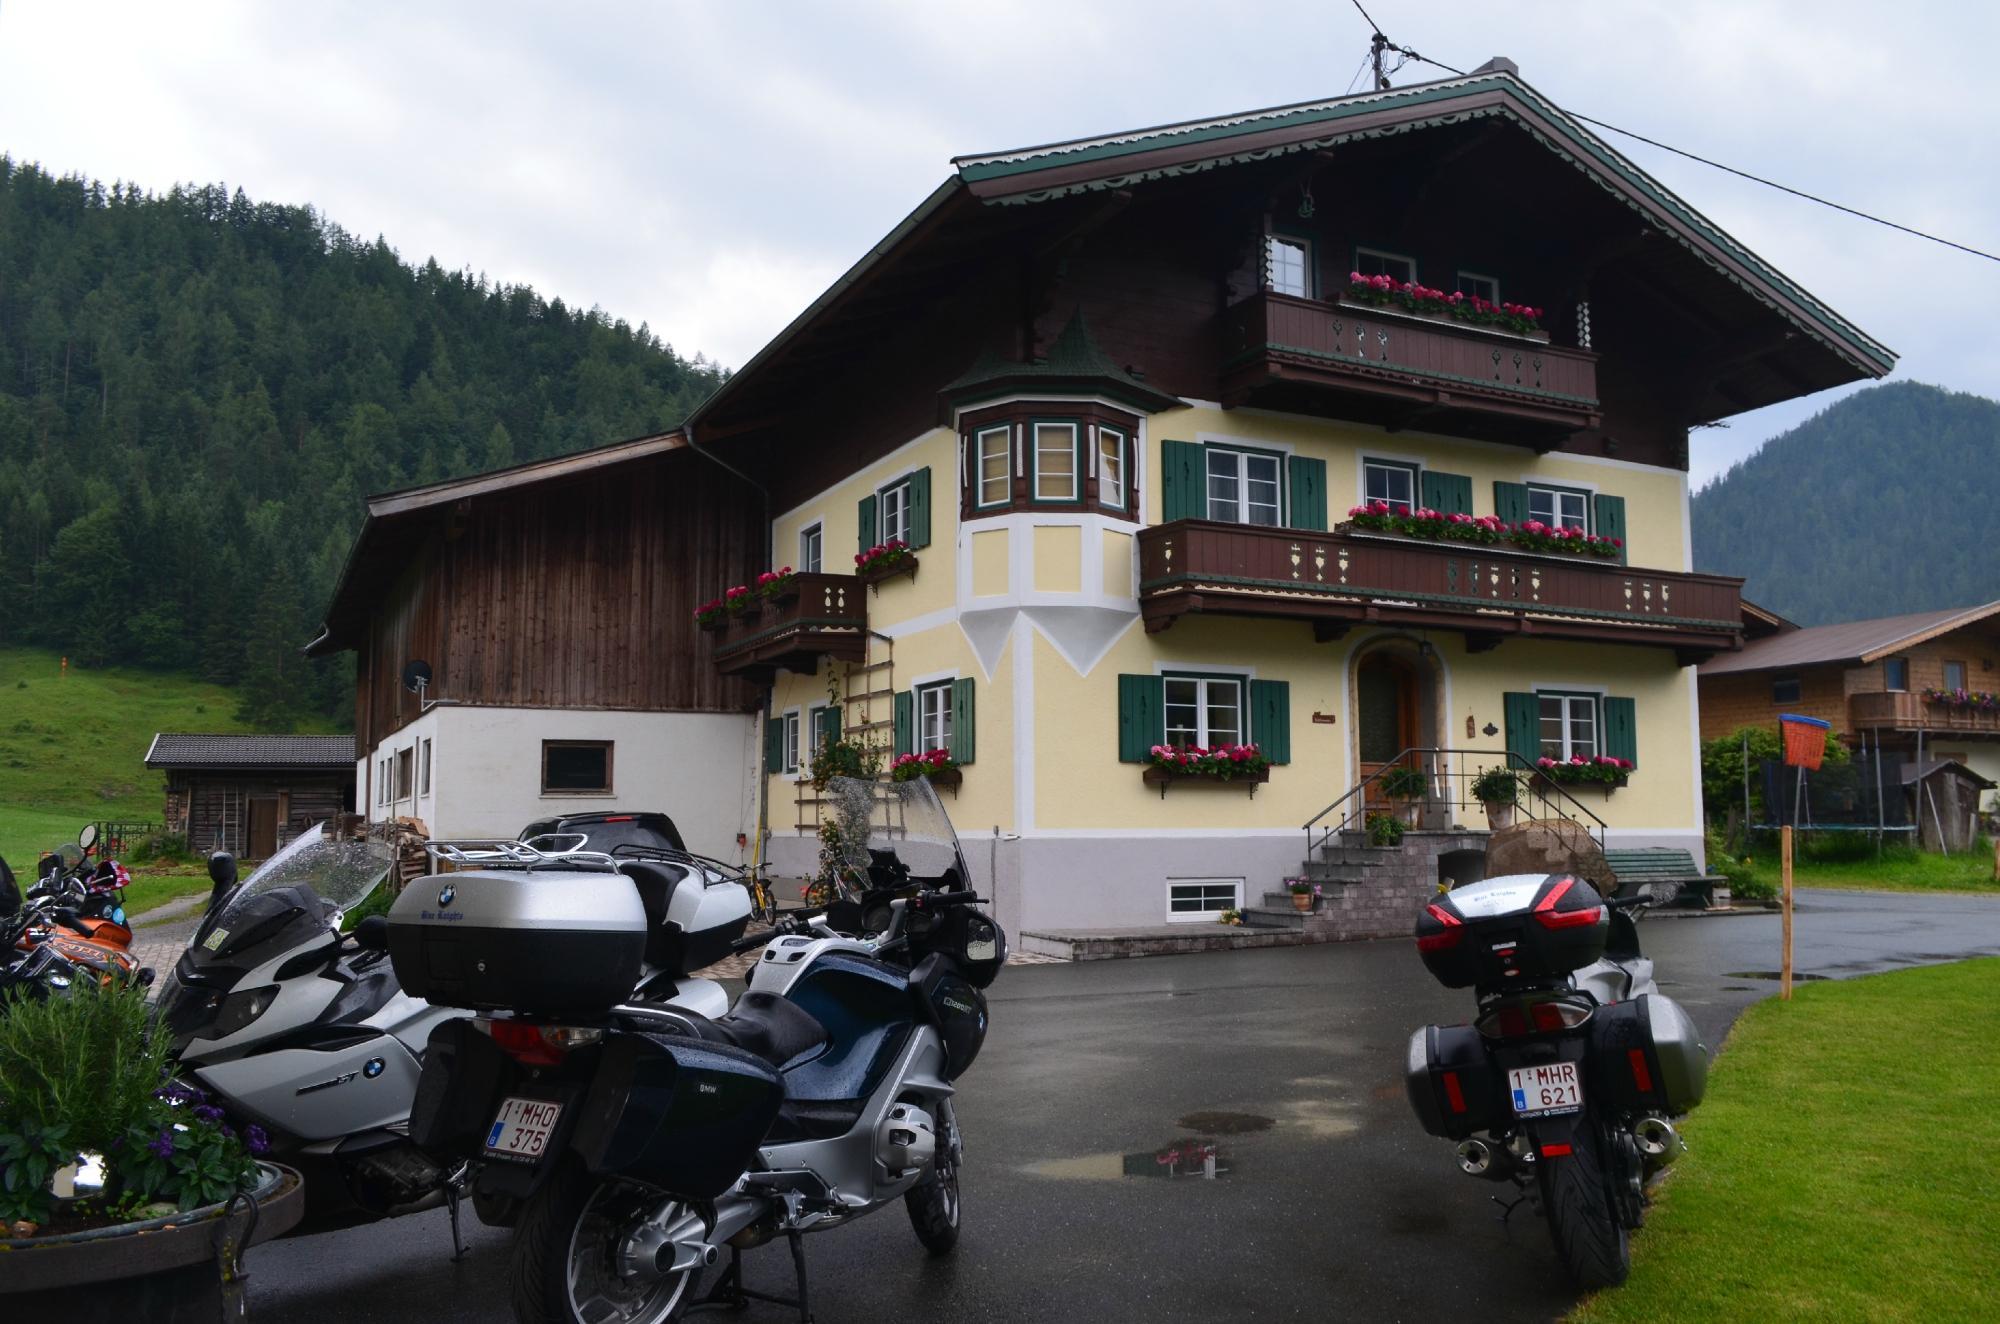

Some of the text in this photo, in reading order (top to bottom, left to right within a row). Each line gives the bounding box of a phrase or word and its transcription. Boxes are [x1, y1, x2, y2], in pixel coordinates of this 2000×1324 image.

[1513, 1064, 1575, 1089] 1 MHR
[1517, 1101, 1524, 1109] B
[1541, 1085, 1577, 1106] 621
[510, 1127, 546, 1152] 375
